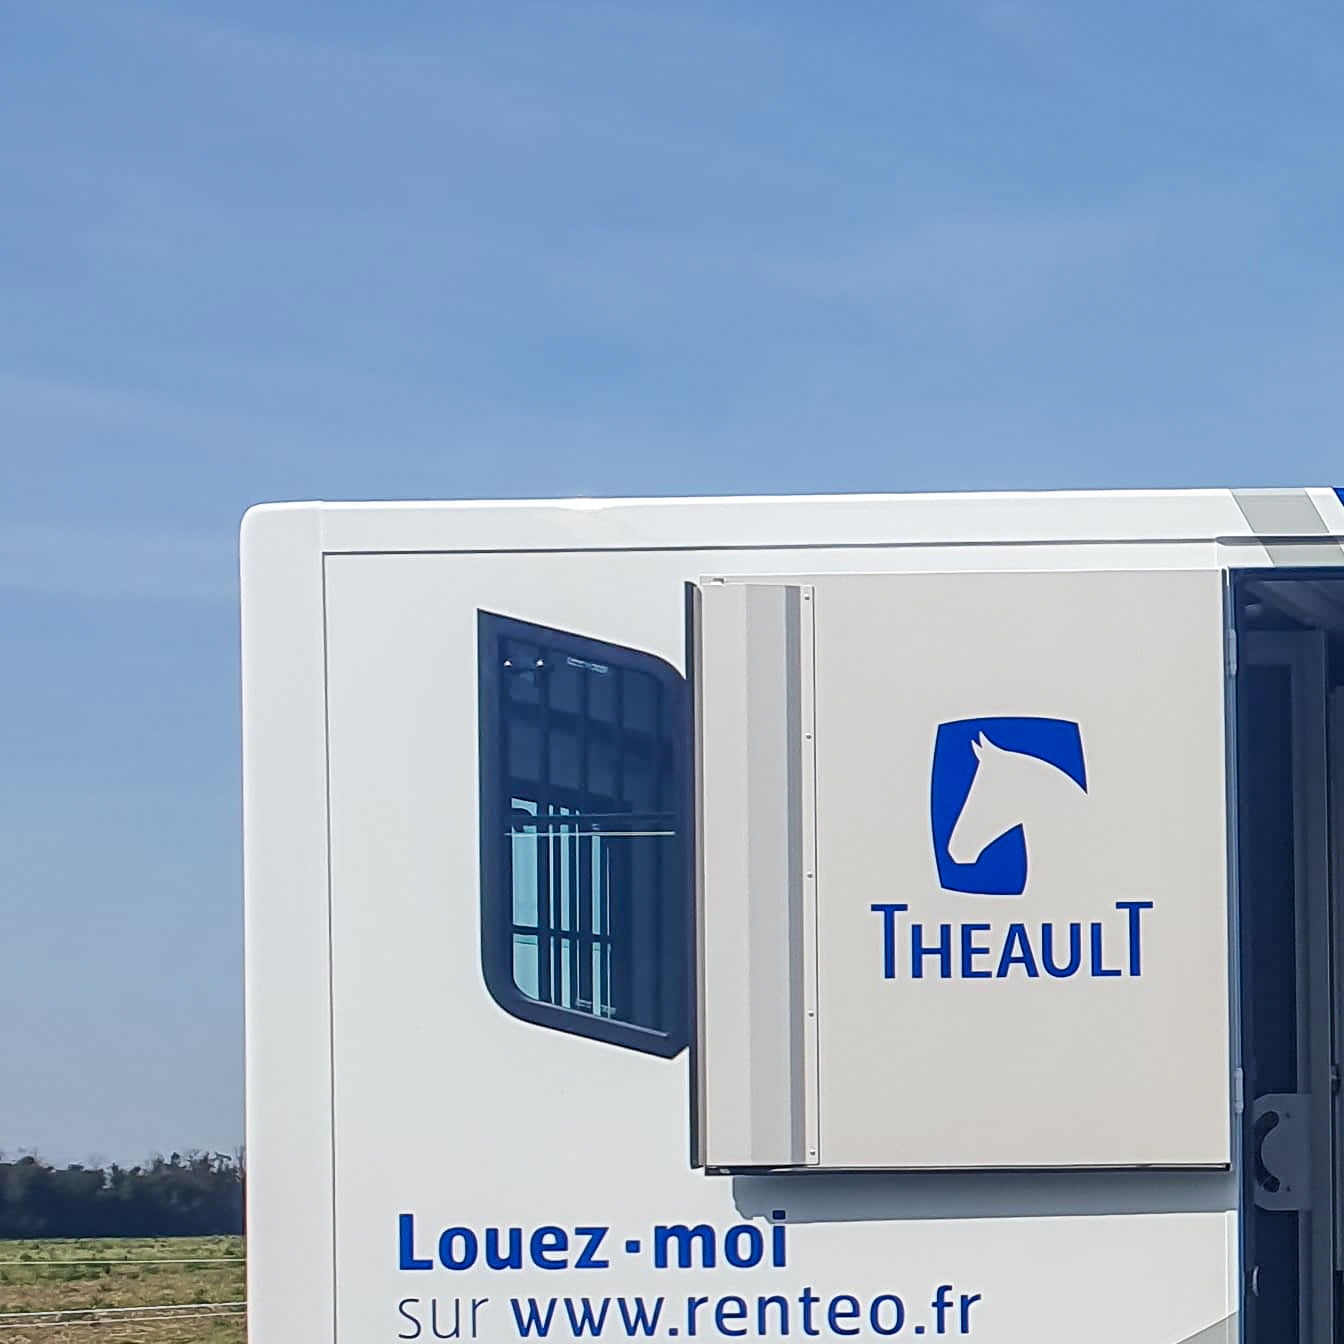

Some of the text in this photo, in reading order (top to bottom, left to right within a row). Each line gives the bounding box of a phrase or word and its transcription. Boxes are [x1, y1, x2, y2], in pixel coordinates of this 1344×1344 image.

[870, 900, 1154, 979] THEAULT
[397, 1284, 982, 1340] sur www.renteo.fr
